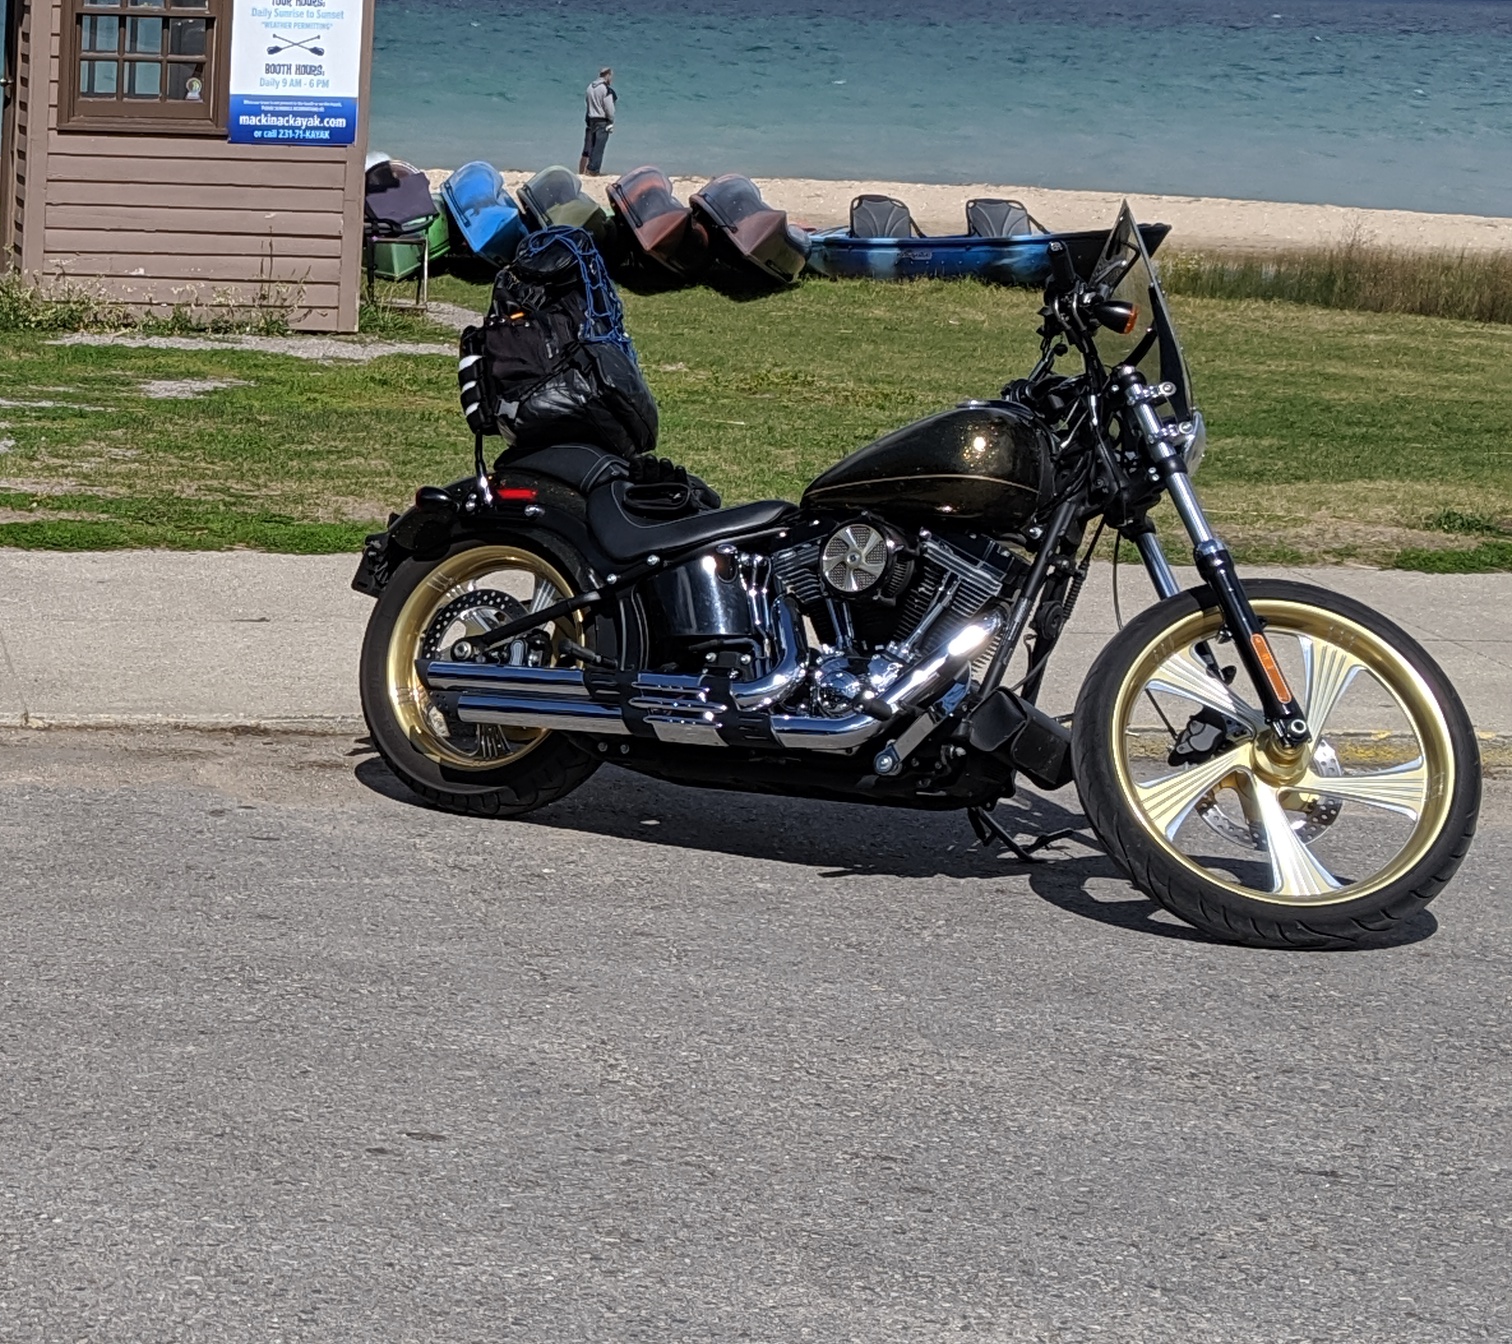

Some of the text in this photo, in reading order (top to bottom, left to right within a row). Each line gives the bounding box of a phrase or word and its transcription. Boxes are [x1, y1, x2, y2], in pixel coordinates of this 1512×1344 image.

[251, 7, 345, 19] Daily Sunrise to Sunset
[264, 63, 292, 75] BOOTH
[259, 77, 280, 89] Daily
[282, 78, 288, 88] 9
[289, 78, 302, 88] AM
[309, 78, 315, 88] 6
[316, 79, 330, 88] PM
[239, 113, 346, 129] mackinackayak.com
[253, 129, 331, 139] or call 231-71-KAYAK
